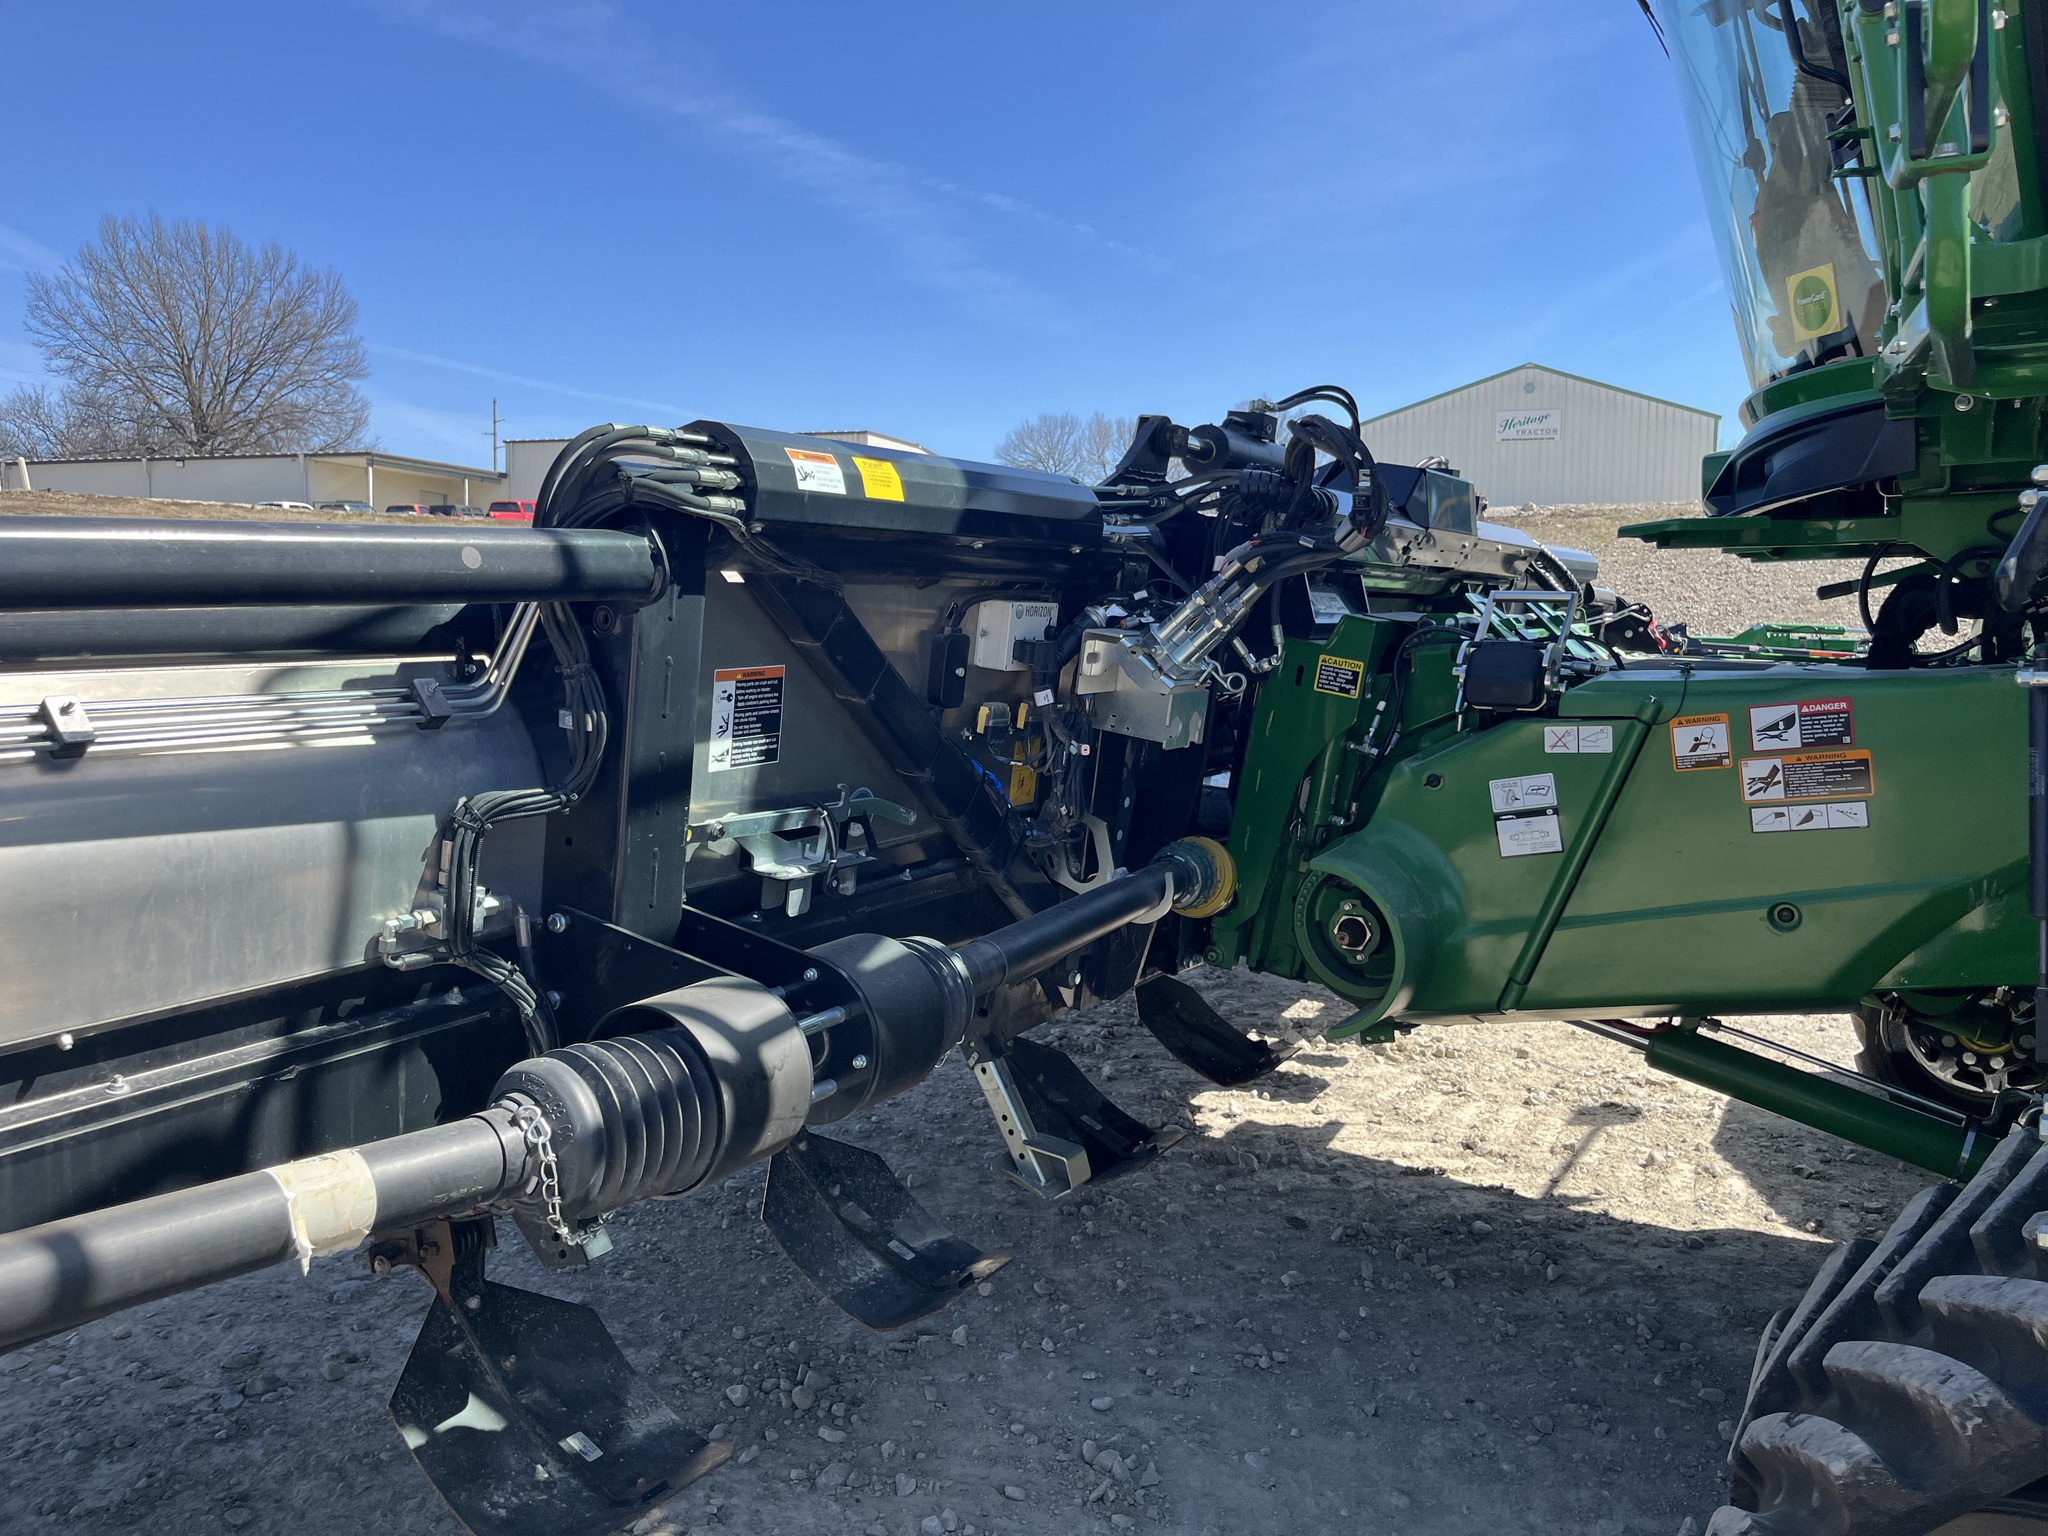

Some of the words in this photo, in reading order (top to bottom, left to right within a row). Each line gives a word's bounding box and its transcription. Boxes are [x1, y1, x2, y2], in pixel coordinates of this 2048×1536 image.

[1498, 412, 1551, 434] Heritage
[1515, 428, 1558, 436] TRACTOR
[1025, 605, 1052, 617] HORIZON
[1328, 658, 1361, 670] CAUTION
[1810, 702, 1847, 711] DANGER
[1684, 716, 1720, 724] WARNING
[1805, 752, 1846, 760] WARNING
